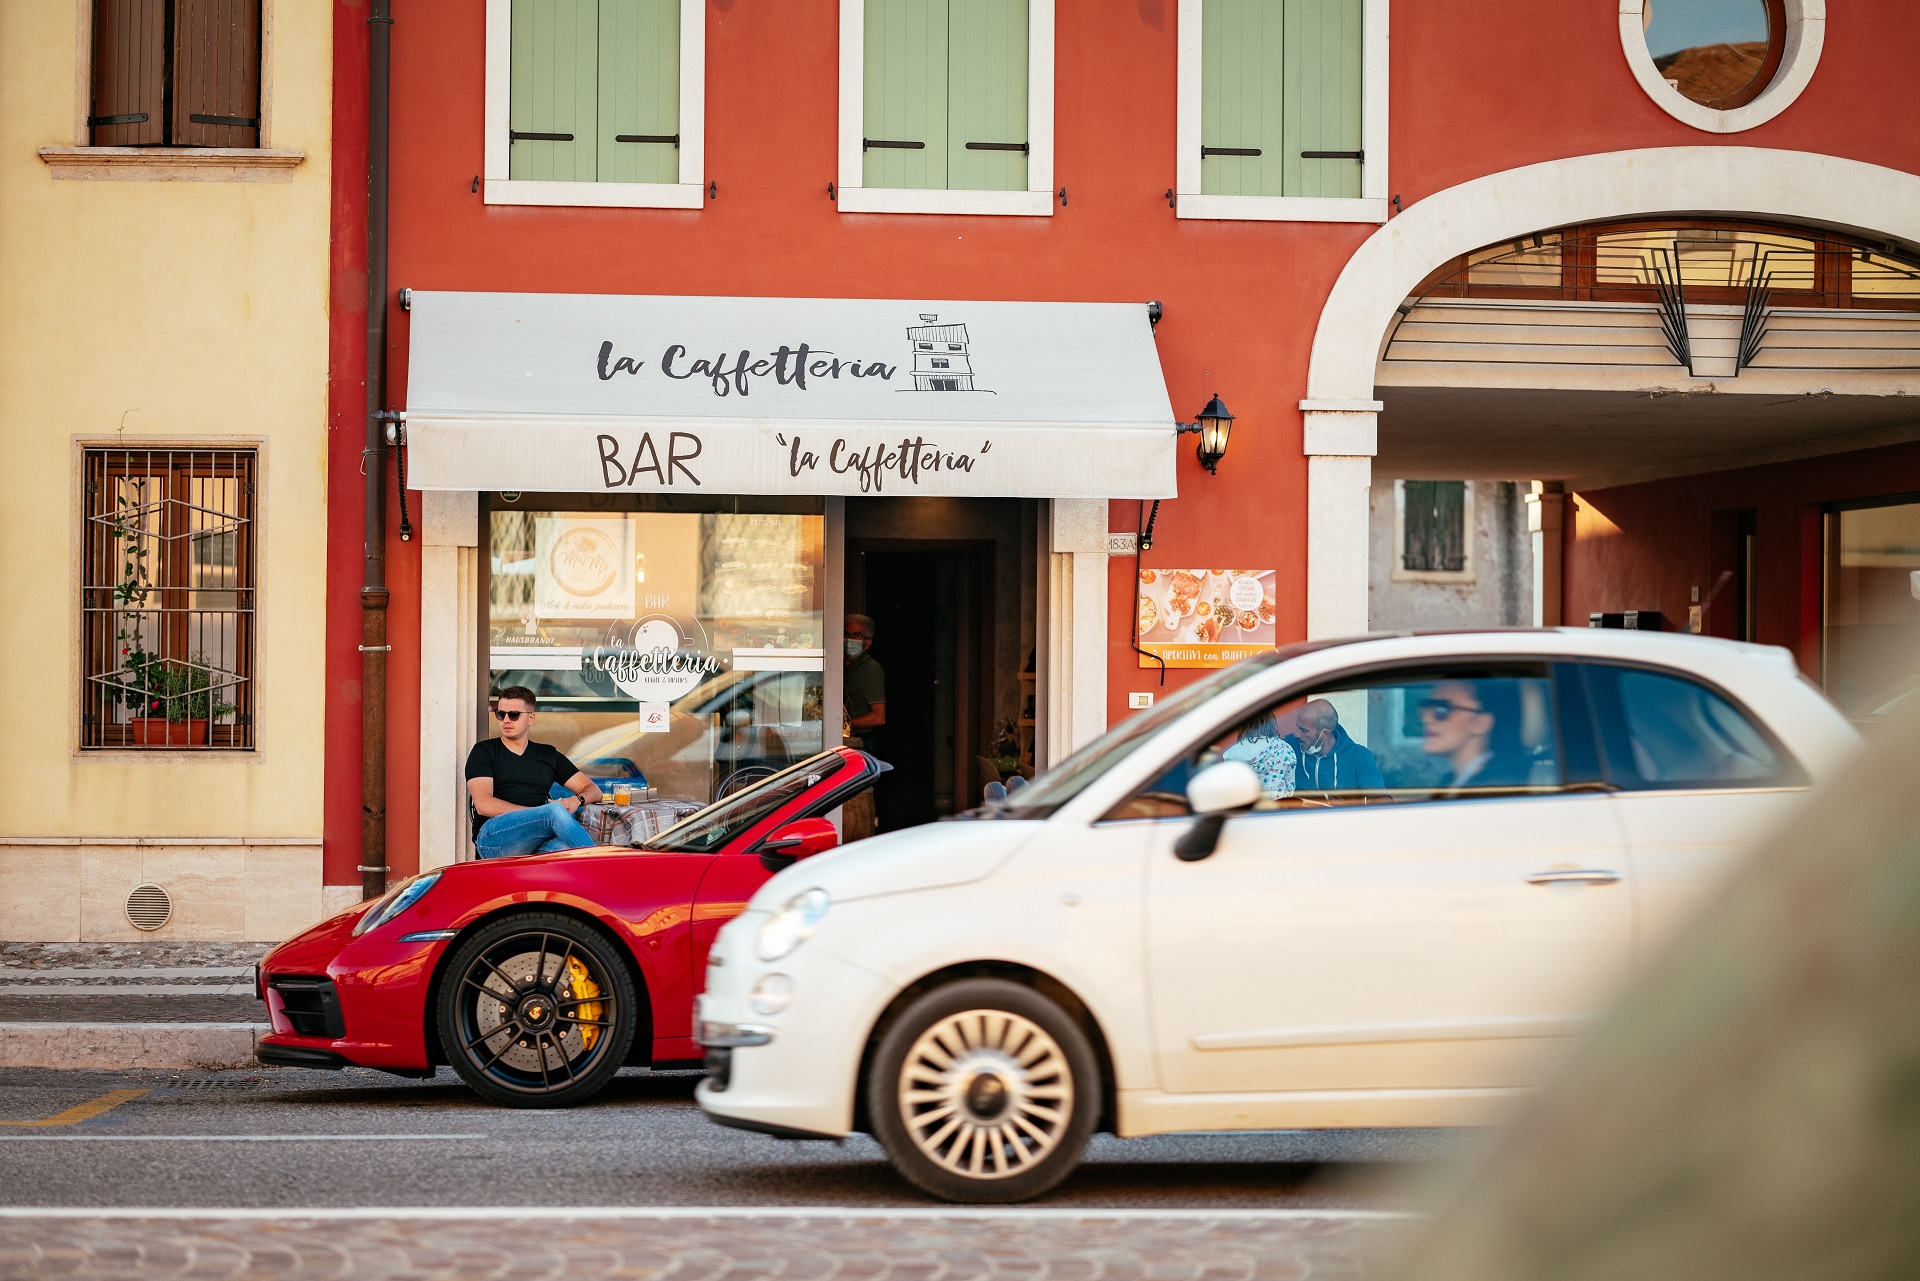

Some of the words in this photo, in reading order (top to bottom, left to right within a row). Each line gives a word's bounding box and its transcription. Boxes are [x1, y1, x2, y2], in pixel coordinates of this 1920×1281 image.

[597, 340, 645, 381] la
[661, 343, 897, 397] Caffetteria
[596, 431, 702, 488] BAR
[644, 593, 671, 609] BAR
[506, 636, 556, 645] HAUSBRANDT
[610, 635, 625, 649] la
[1162, 649, 1201, 661] APERITIVI
[1203, 652, 1219, 661] con
[593, 646, 721, 683] Caffetteria
